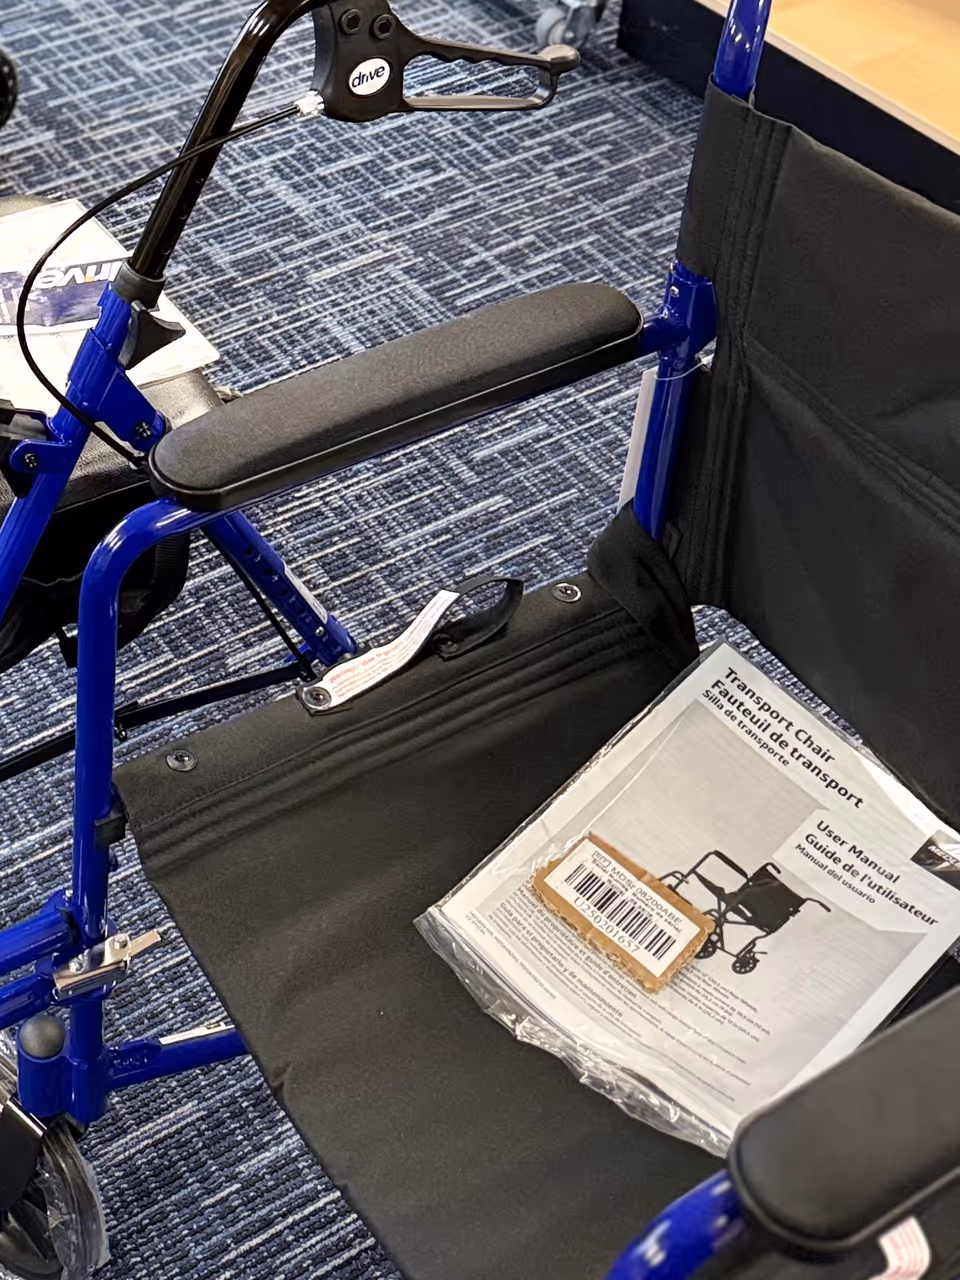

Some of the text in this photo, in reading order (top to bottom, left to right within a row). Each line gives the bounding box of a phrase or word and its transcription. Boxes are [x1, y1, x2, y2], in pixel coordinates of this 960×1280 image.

[351, 66, 385, 88] drive
[701, 688, 790, 767] Silla de transporte
[709, 677, 865, 809] Fauteuil de transport
[721, 667, 837, 765] Transport Chair
[594, 852, 607, 864] REF
[794, 843, 877, 904] Manual del usuario
[803, 830, 940, 928] Guide de l'utilisateur
[815, 819, 900, 885] User Manual
[515, 886, 537, 910] Manuel
[535, 907, 545, 917] du
[542, 915, 580, 950] propriétaire
[578, 947, 586, 956] et
[584, 954, 603, 971] guide
[573, 895, 640, 954] U250201657
[510, 915, 526, 931] para
[525, 928, 532, 936] el
[529, 934, 565, 968] propietario
[567, 970, 576, 980] de
[575, 978, 624, 1018] mantenimiento
